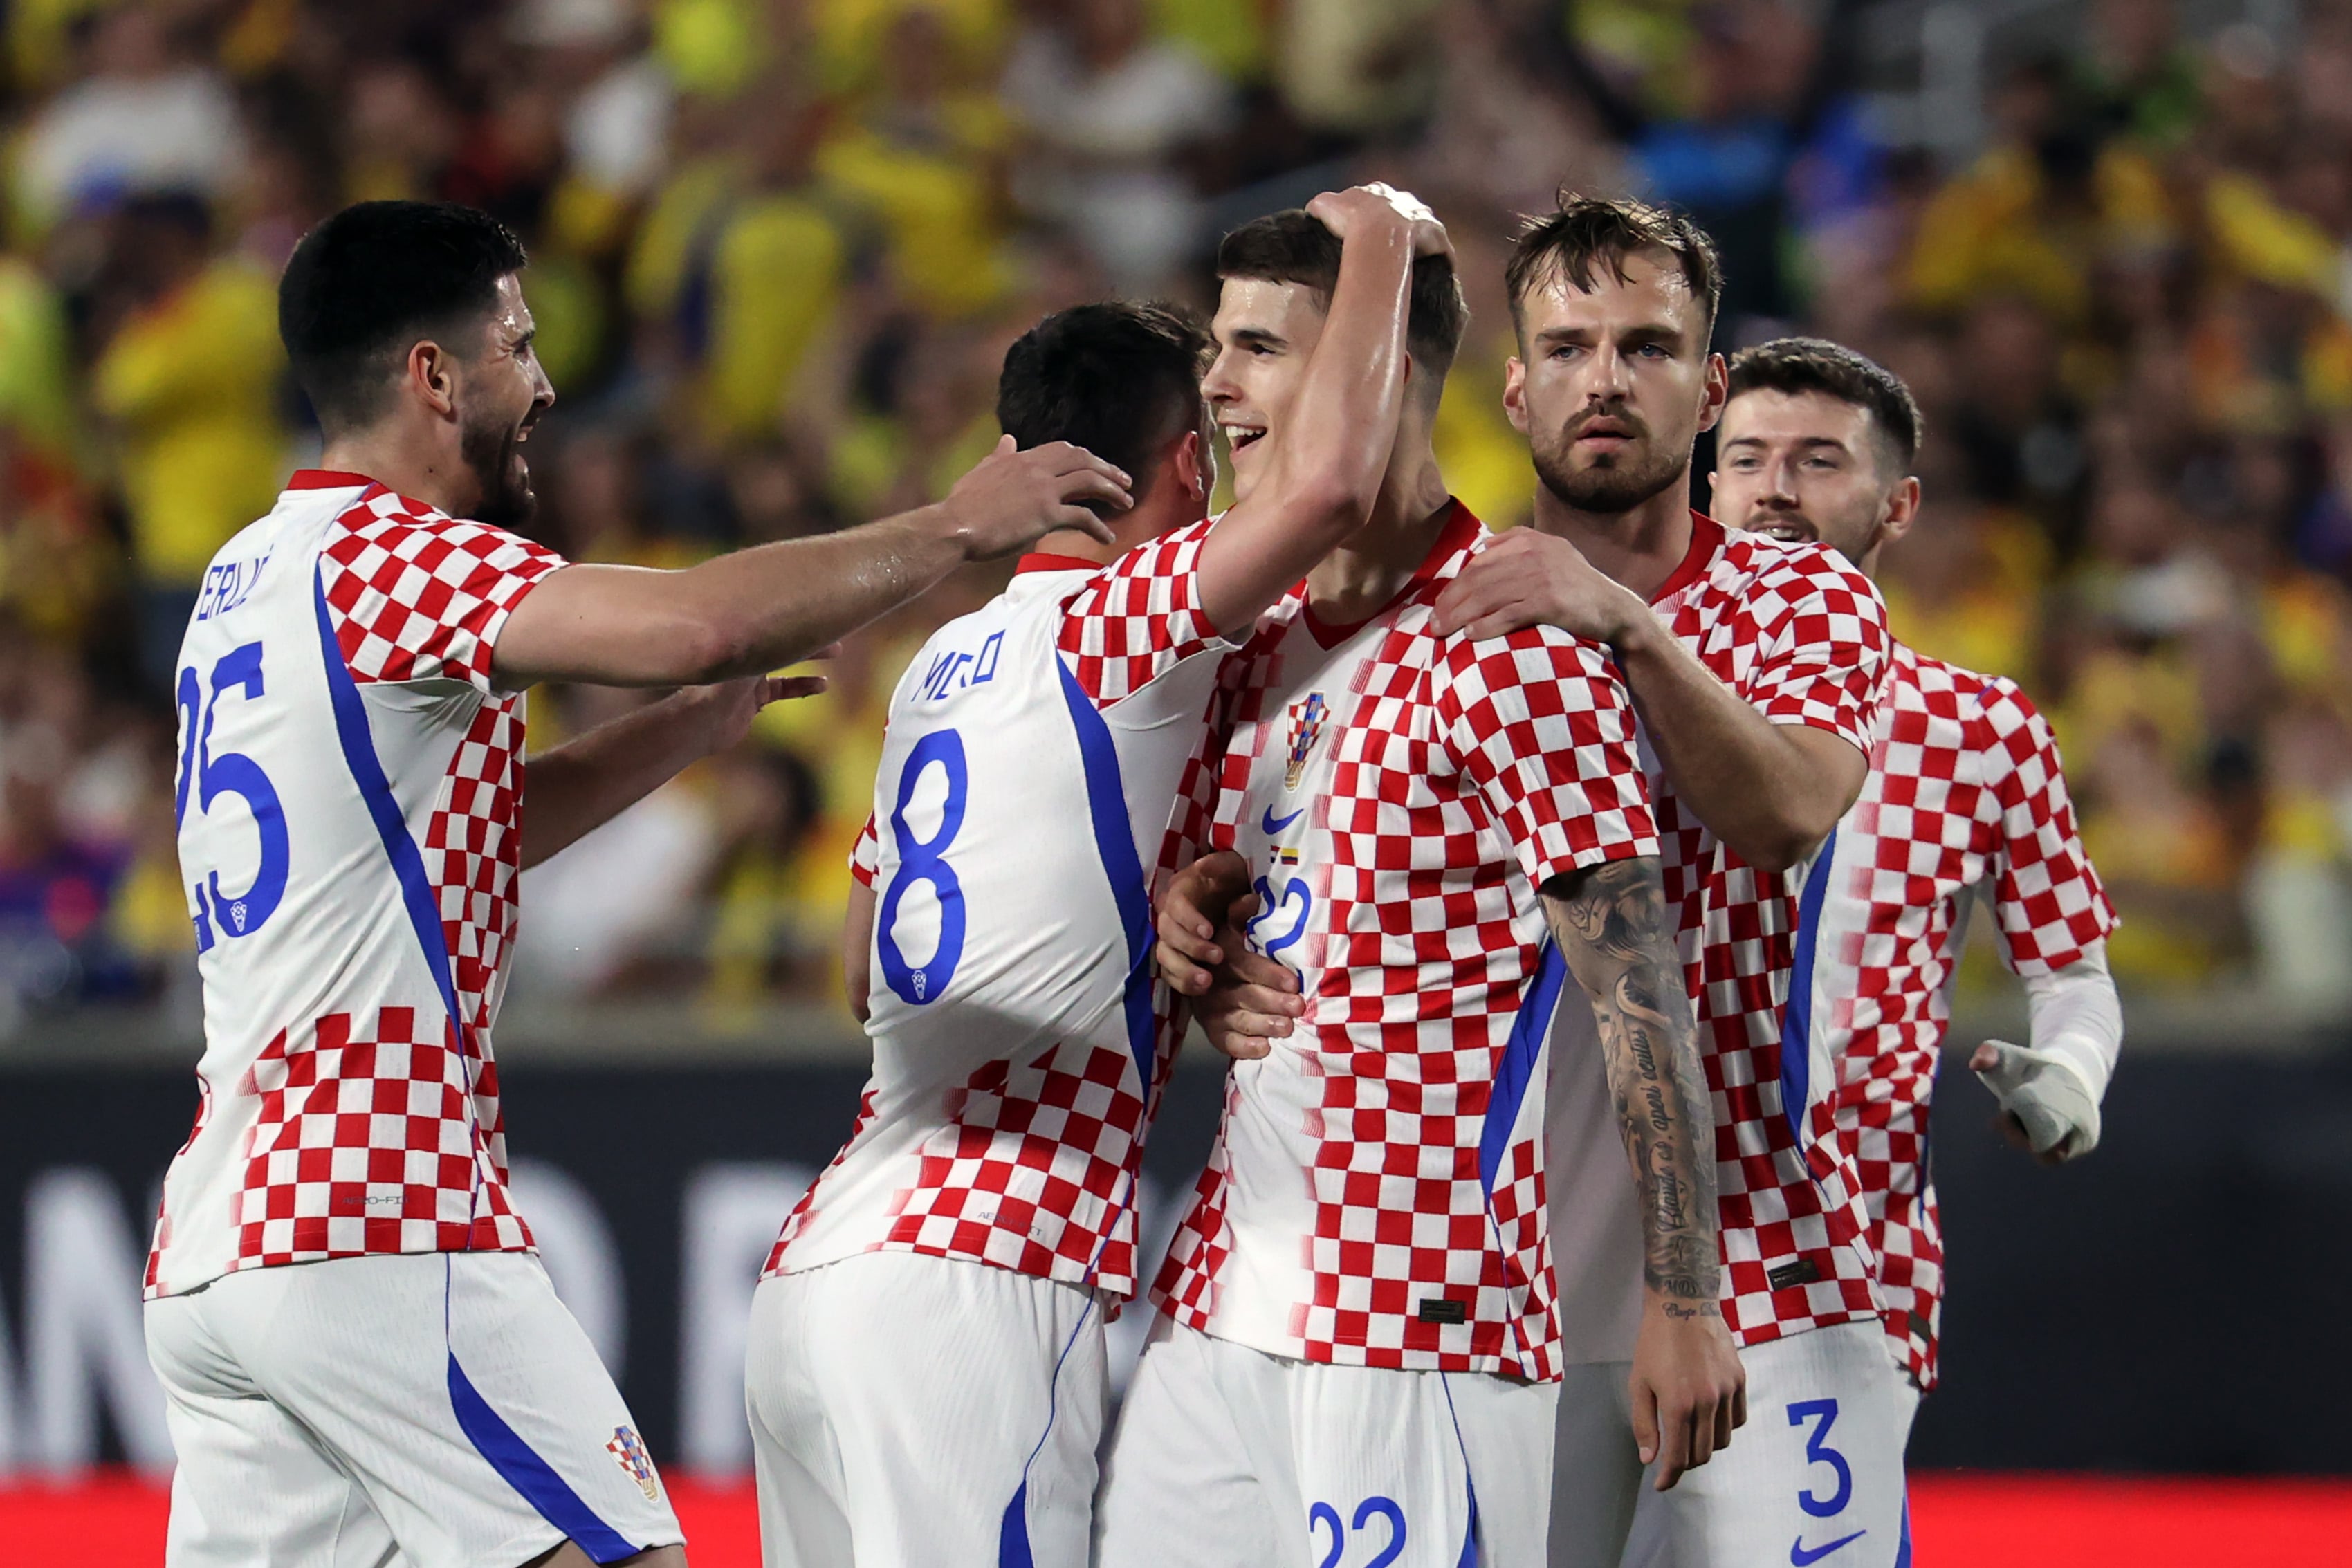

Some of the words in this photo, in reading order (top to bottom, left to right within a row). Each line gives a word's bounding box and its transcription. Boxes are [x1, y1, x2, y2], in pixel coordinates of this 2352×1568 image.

[877, 728, 968, 1006] 8
[1786, 1398, 1852, 1518] 3
[1309, 1495, 1407, 1568] 22
